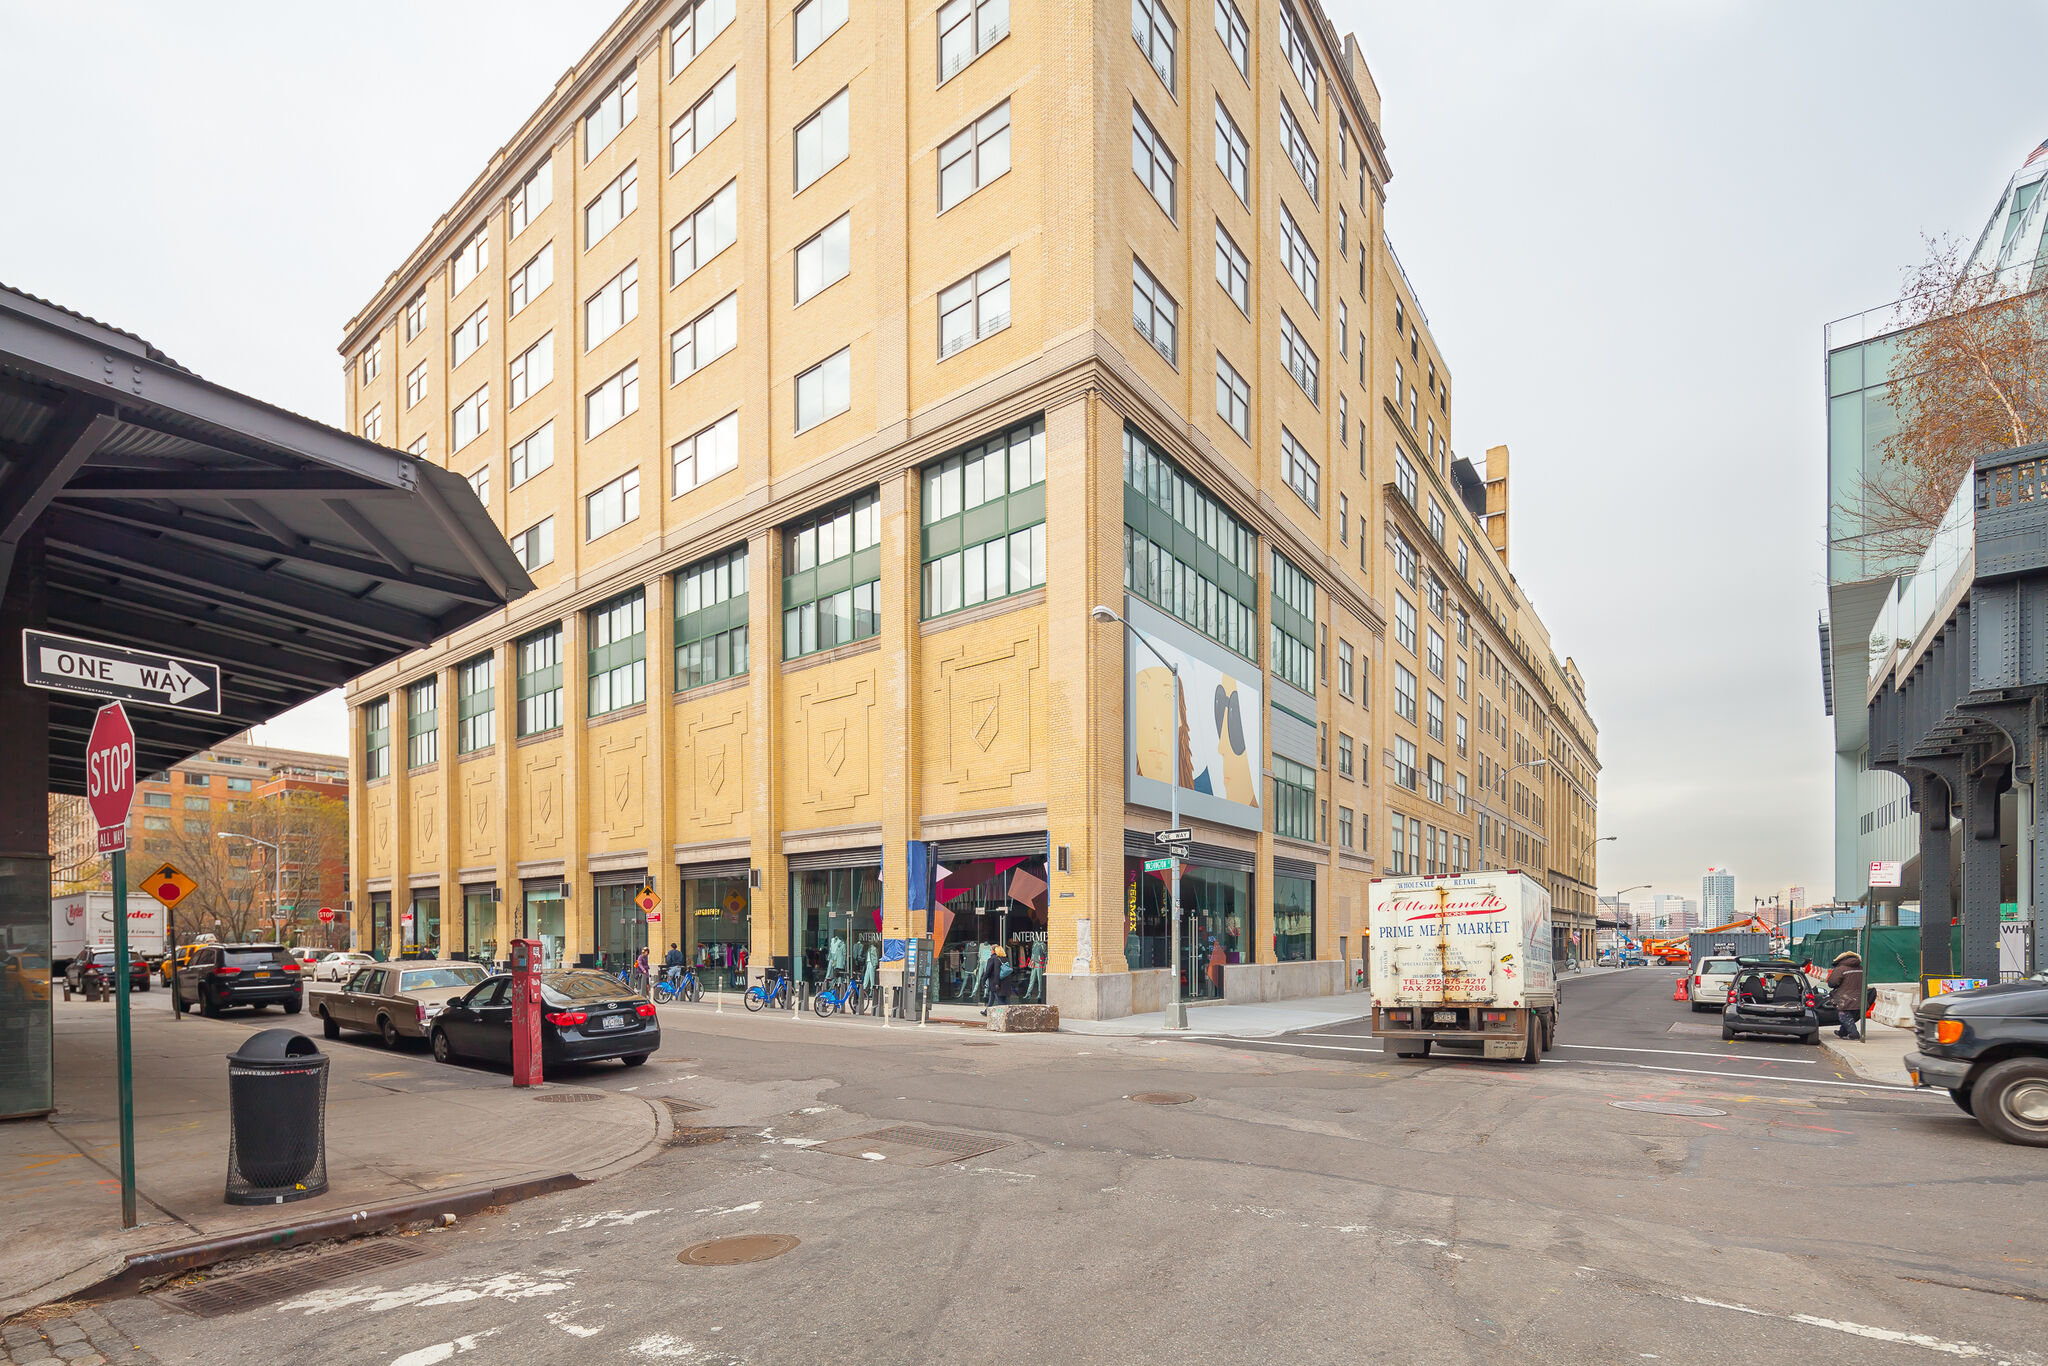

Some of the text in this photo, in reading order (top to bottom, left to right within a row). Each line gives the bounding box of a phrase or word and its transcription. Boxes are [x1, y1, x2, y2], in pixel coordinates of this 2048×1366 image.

[57, 654, 192, 693] ONE WAY
[67, 684, 113, 695] TRANSPORTATION
[91, 742, 131, 798] STOP
[100, 829, 123, 848] ALL WAY
[1398, 881, 1434, 889] WHOLESALE
[1129, 870, 1137, 931] INTERMIX
[127, 910, 154, 920] yder
[1379, 921, 1510, 938] PRIME MEAT MARKET
[1018, 957, 1046, 968] SALE
